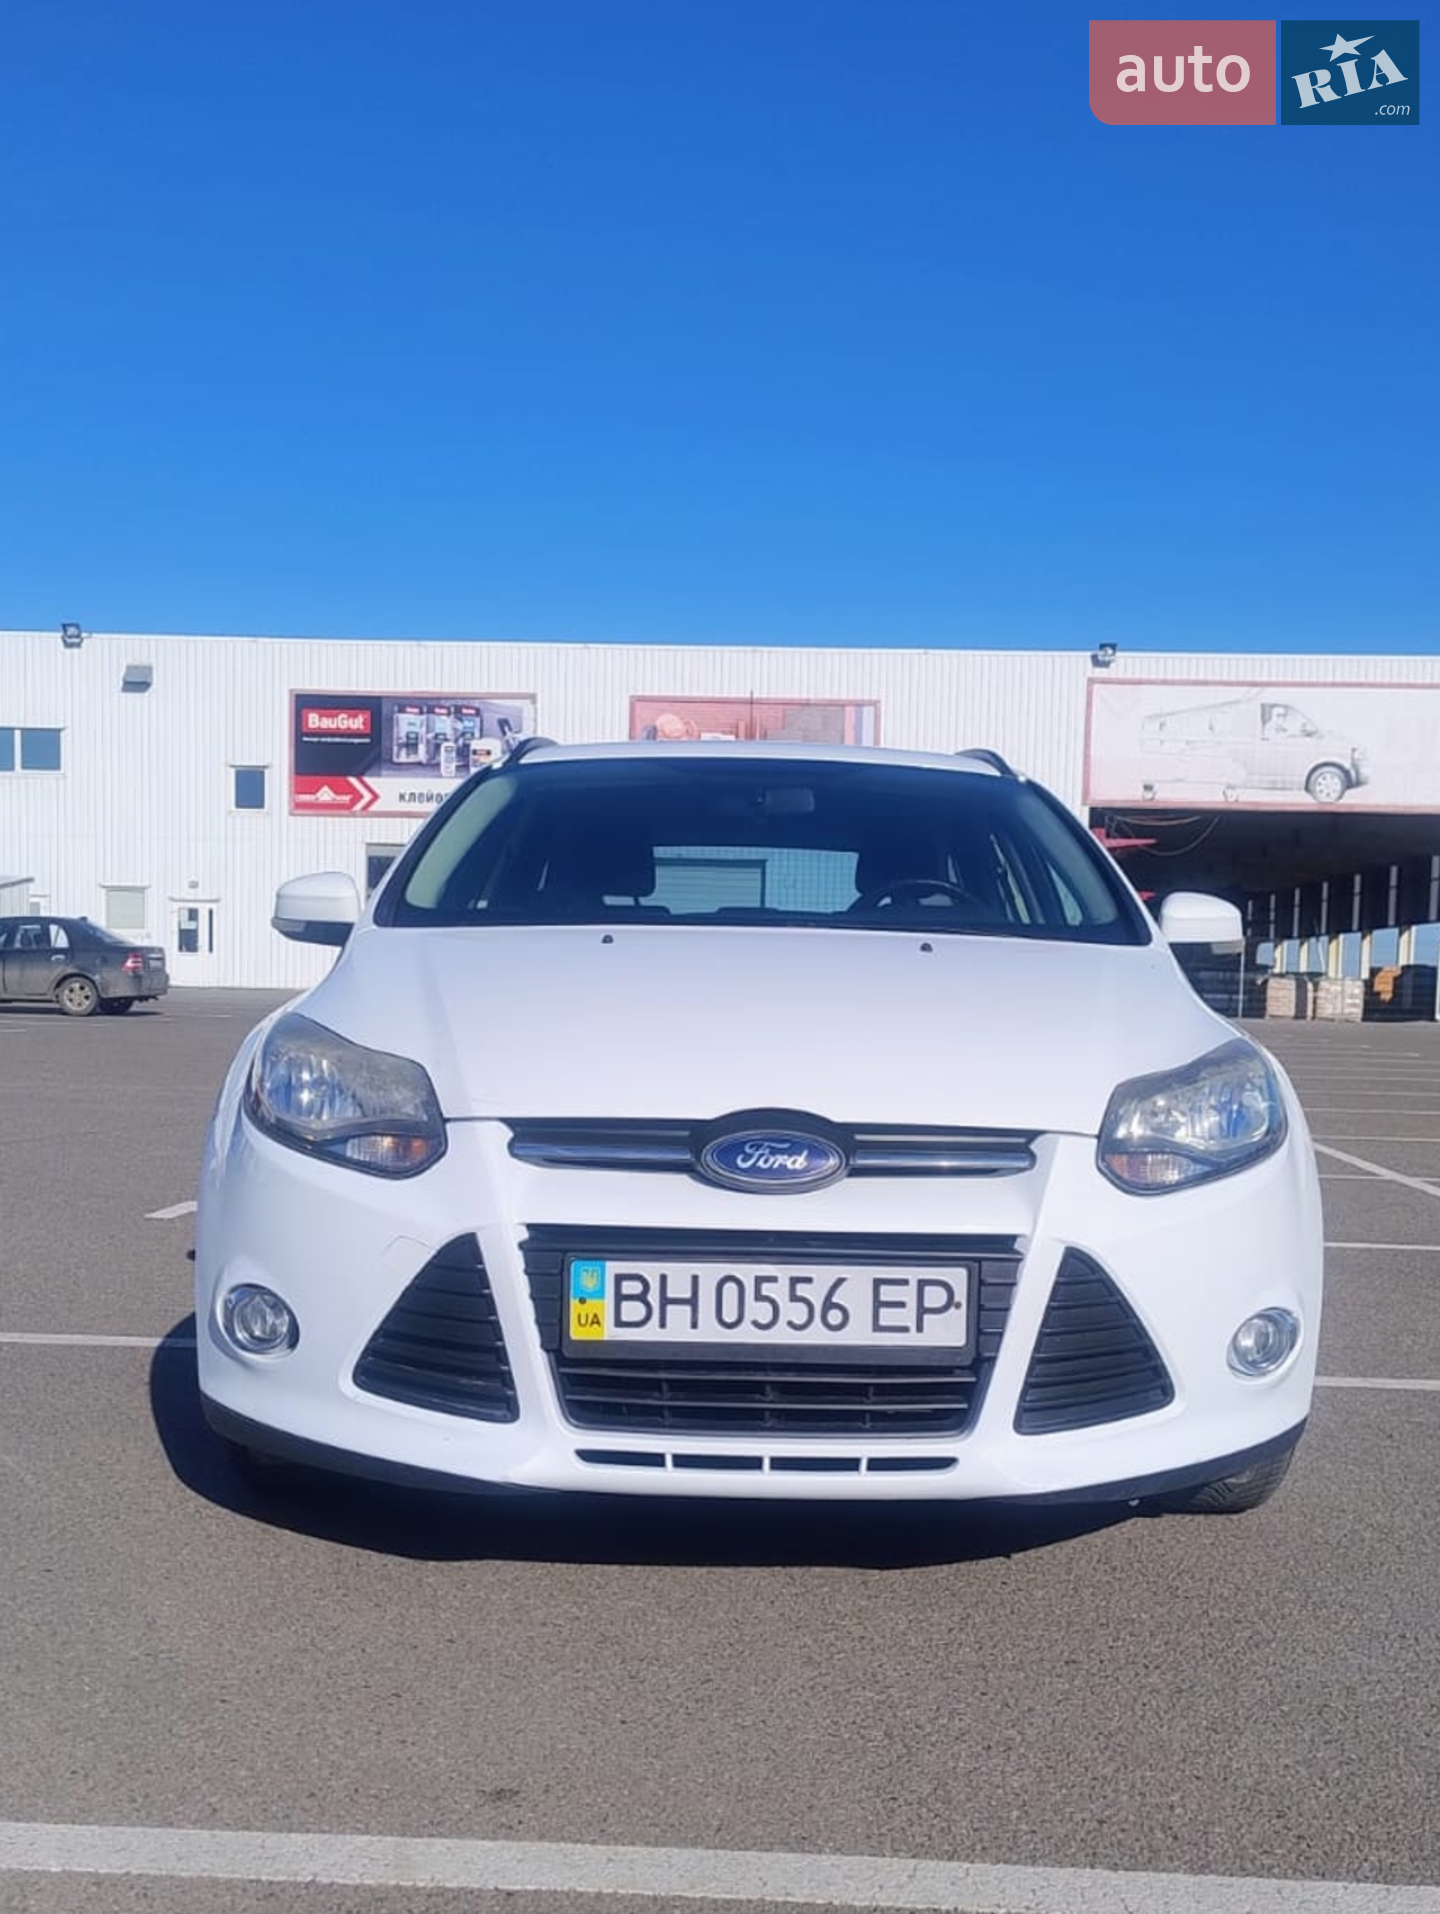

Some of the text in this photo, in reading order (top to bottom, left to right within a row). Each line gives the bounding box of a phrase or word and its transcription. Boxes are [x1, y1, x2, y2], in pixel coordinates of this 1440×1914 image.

[308, 712, 365, 730] BauGut
[736, 1141, 809, 1169] Ford
[613, 1273, 956, 1333] BH 0556 EP
[577, 1312, 601, 1329] UA
